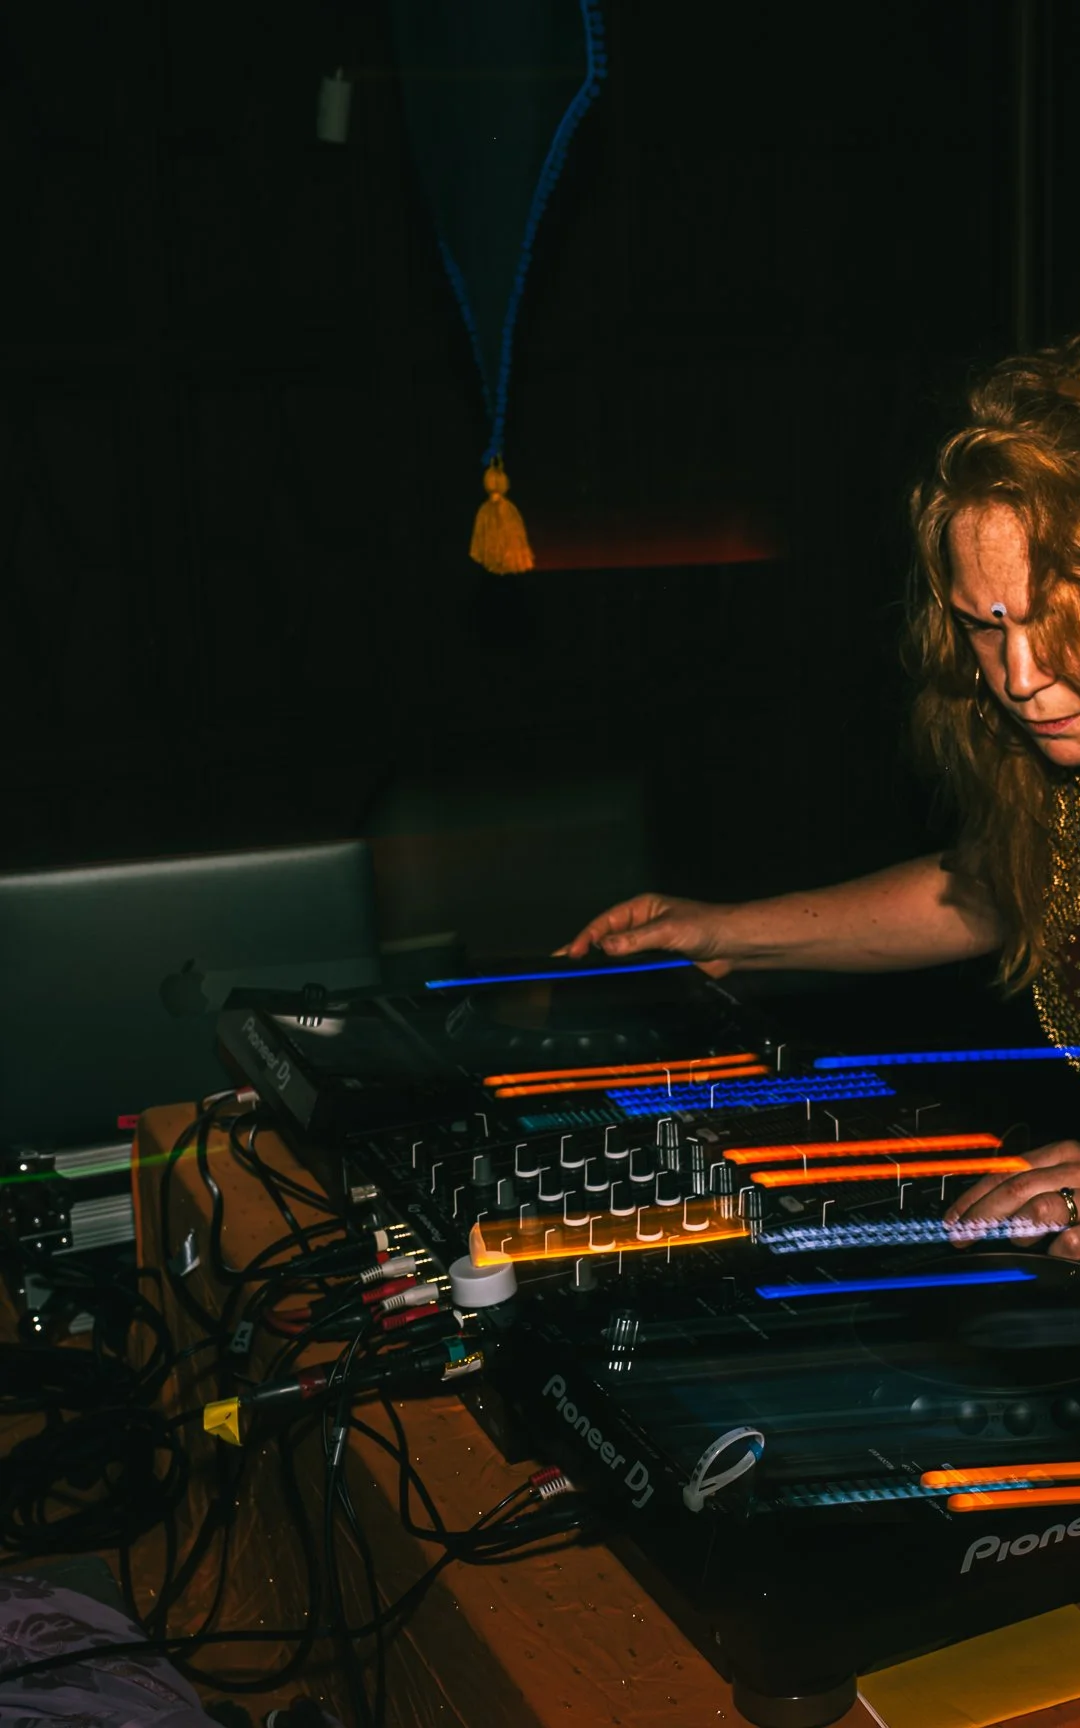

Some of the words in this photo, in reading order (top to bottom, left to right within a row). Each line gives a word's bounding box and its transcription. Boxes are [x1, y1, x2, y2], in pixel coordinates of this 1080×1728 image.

[242, 1016, 279, 1070] Pioneer
[276, 1061, 291, 1091] DJ
[541, 1374, 626, 1470] Pioneer
[624, 1460, 654, 1509] DJ
